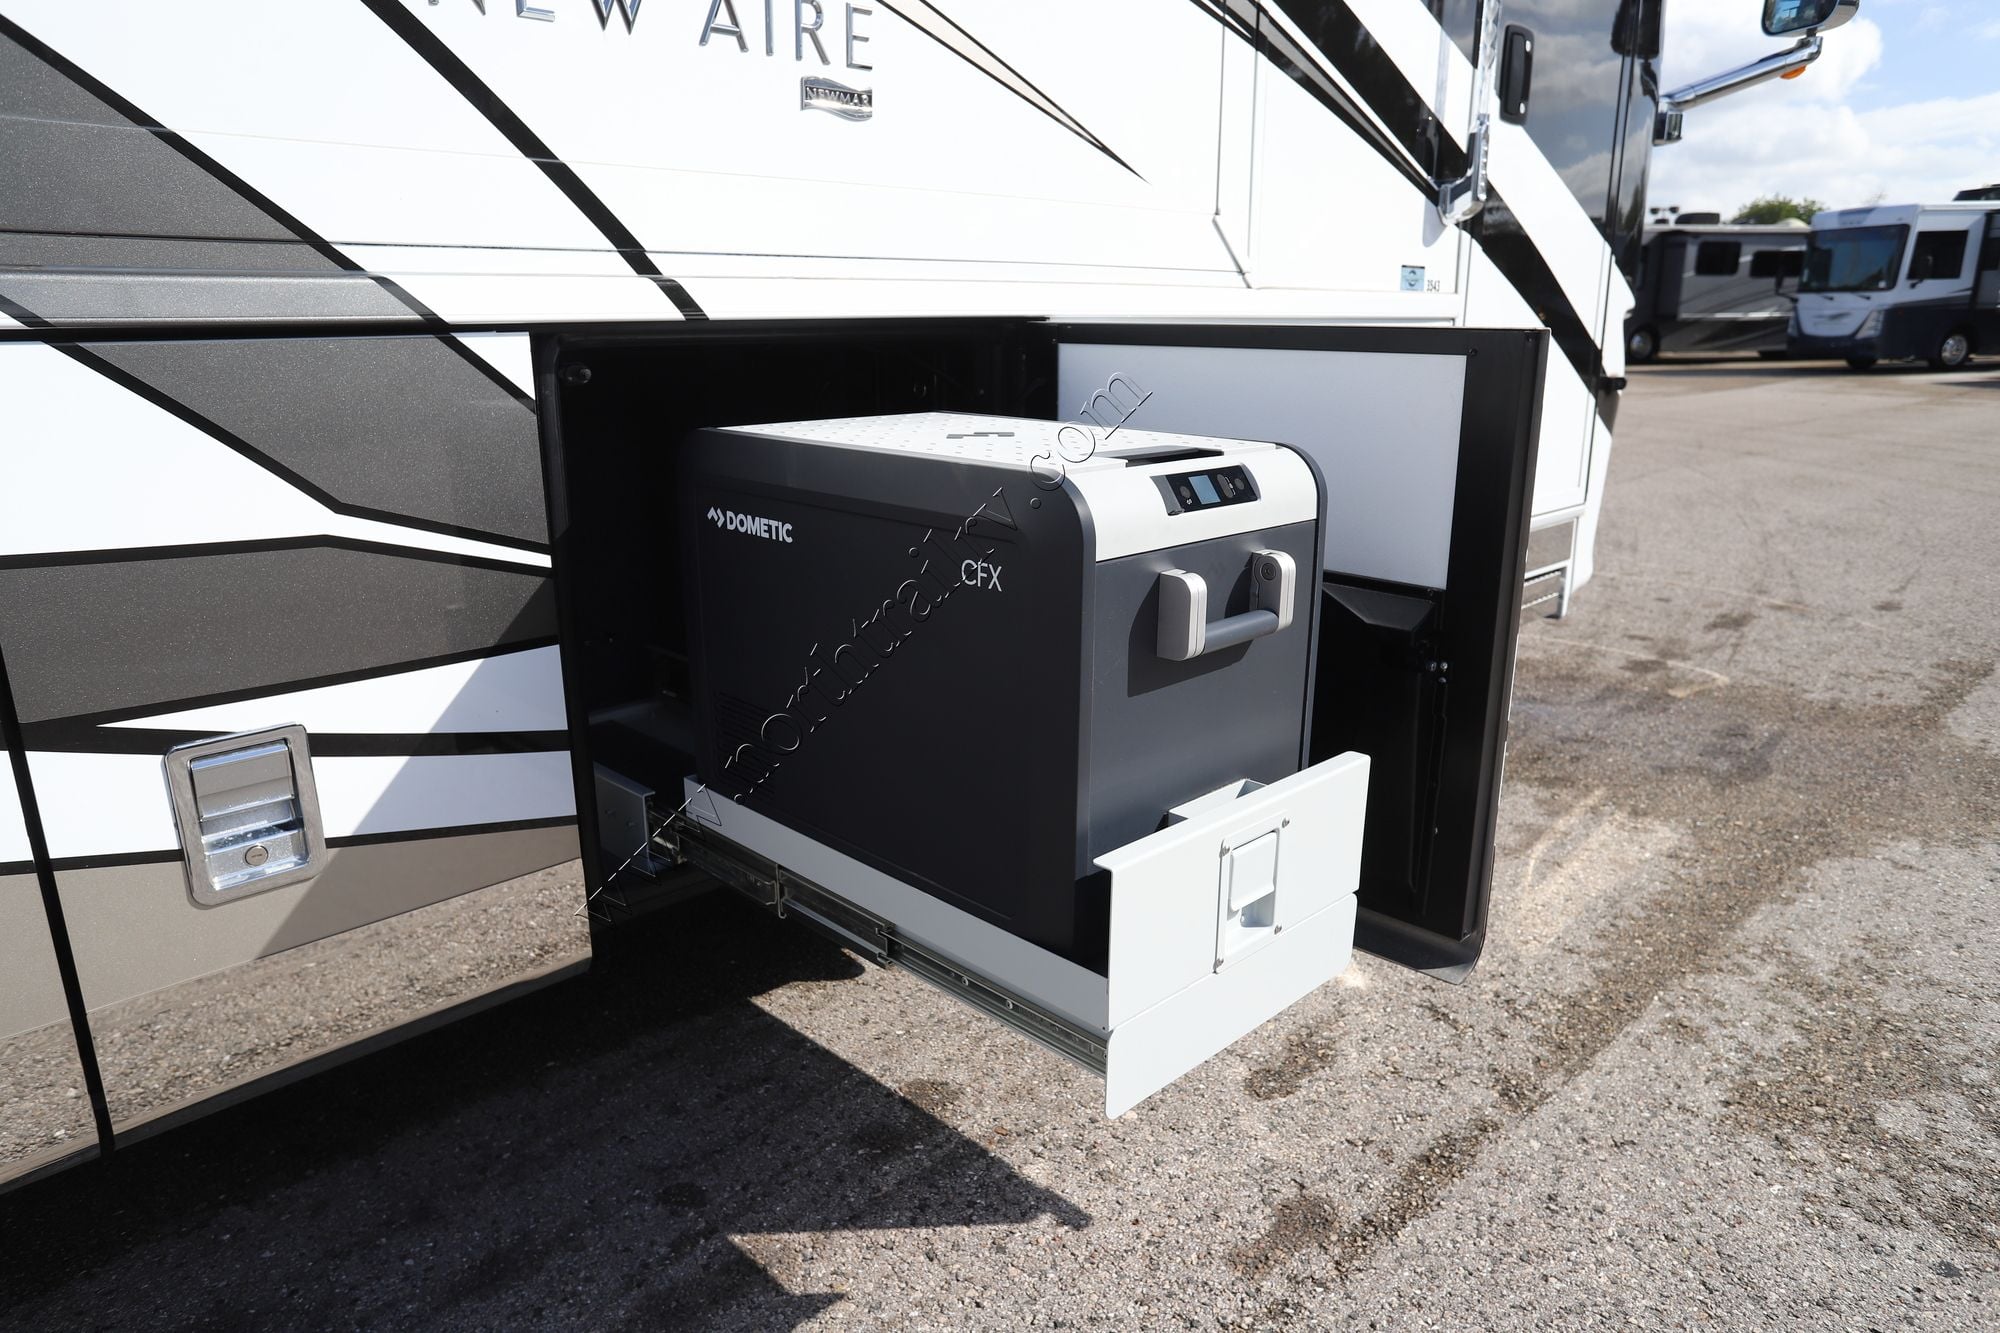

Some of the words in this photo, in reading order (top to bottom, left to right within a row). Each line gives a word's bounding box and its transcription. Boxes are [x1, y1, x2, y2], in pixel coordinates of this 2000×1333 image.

[699, 0, 872, 71] AIRE
[805, 86, 870, 107] NEWMAR
[726, 510, 793, 543] DOMETIC
[961, 558, 1002, 592] CFX
